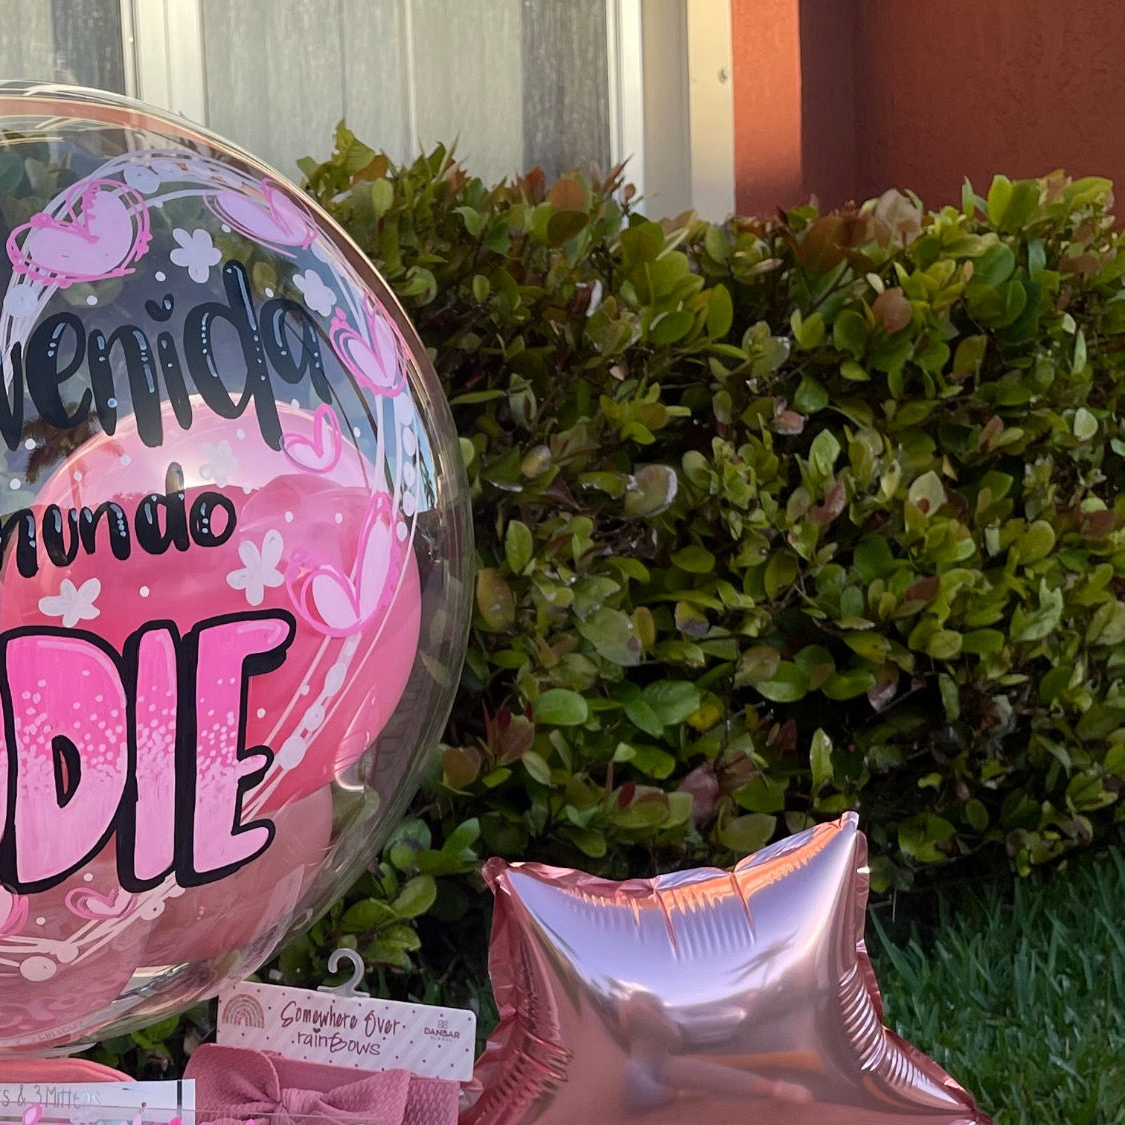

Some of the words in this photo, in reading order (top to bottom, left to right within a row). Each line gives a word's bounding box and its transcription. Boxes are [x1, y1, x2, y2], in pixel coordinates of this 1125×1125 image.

[281, 1000, 358, 1030] Somewhere
[364, 1010, 401, 1038] Over
[424, 1027, 460, 1040] DANBAR
